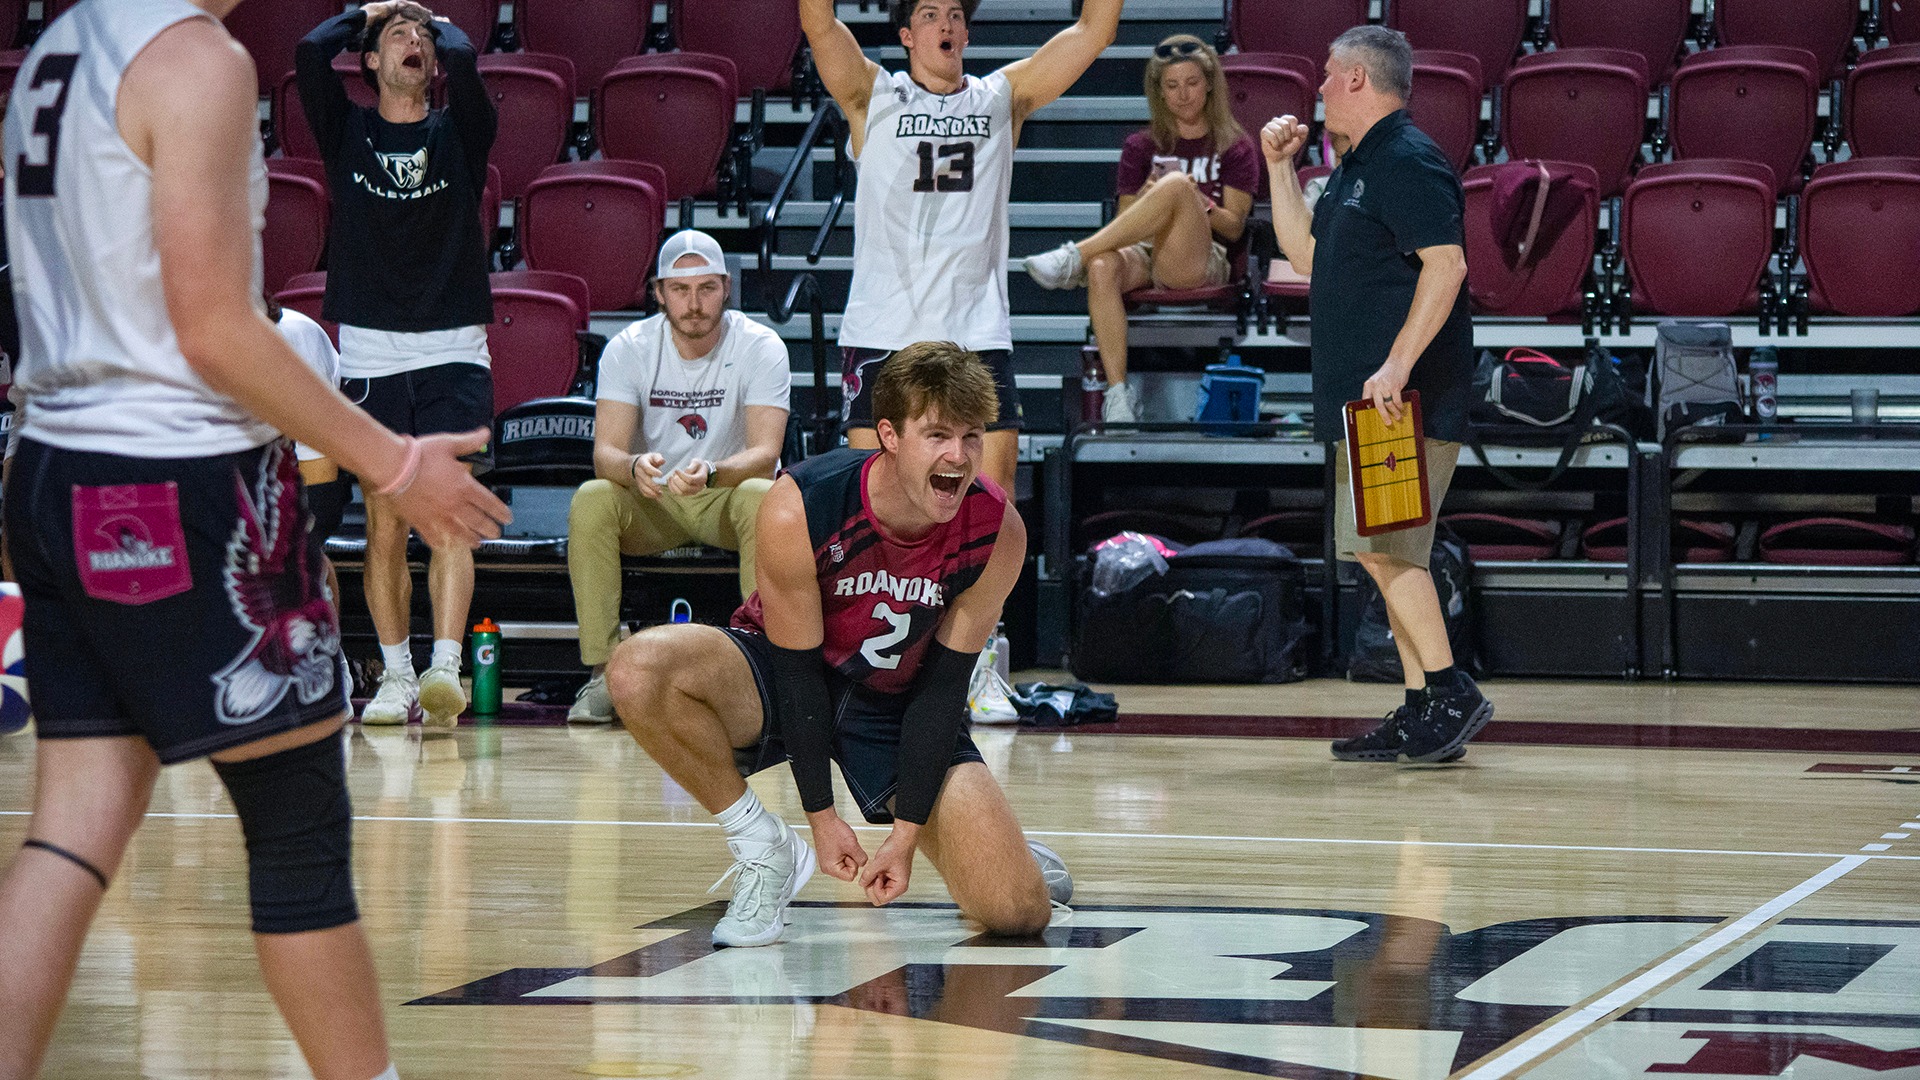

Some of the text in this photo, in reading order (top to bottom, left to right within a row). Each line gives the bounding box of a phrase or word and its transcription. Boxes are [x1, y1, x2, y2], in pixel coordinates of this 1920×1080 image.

[16, 53, 80, 197] 3
[896, 113, 992, 139] ROANOKE
[353, 172, 449, 200] VLLEYBALL
[913, 141, 975, 193] 13
[476, 643, 495, 666] G
[859, 601, 912, 670] 2
